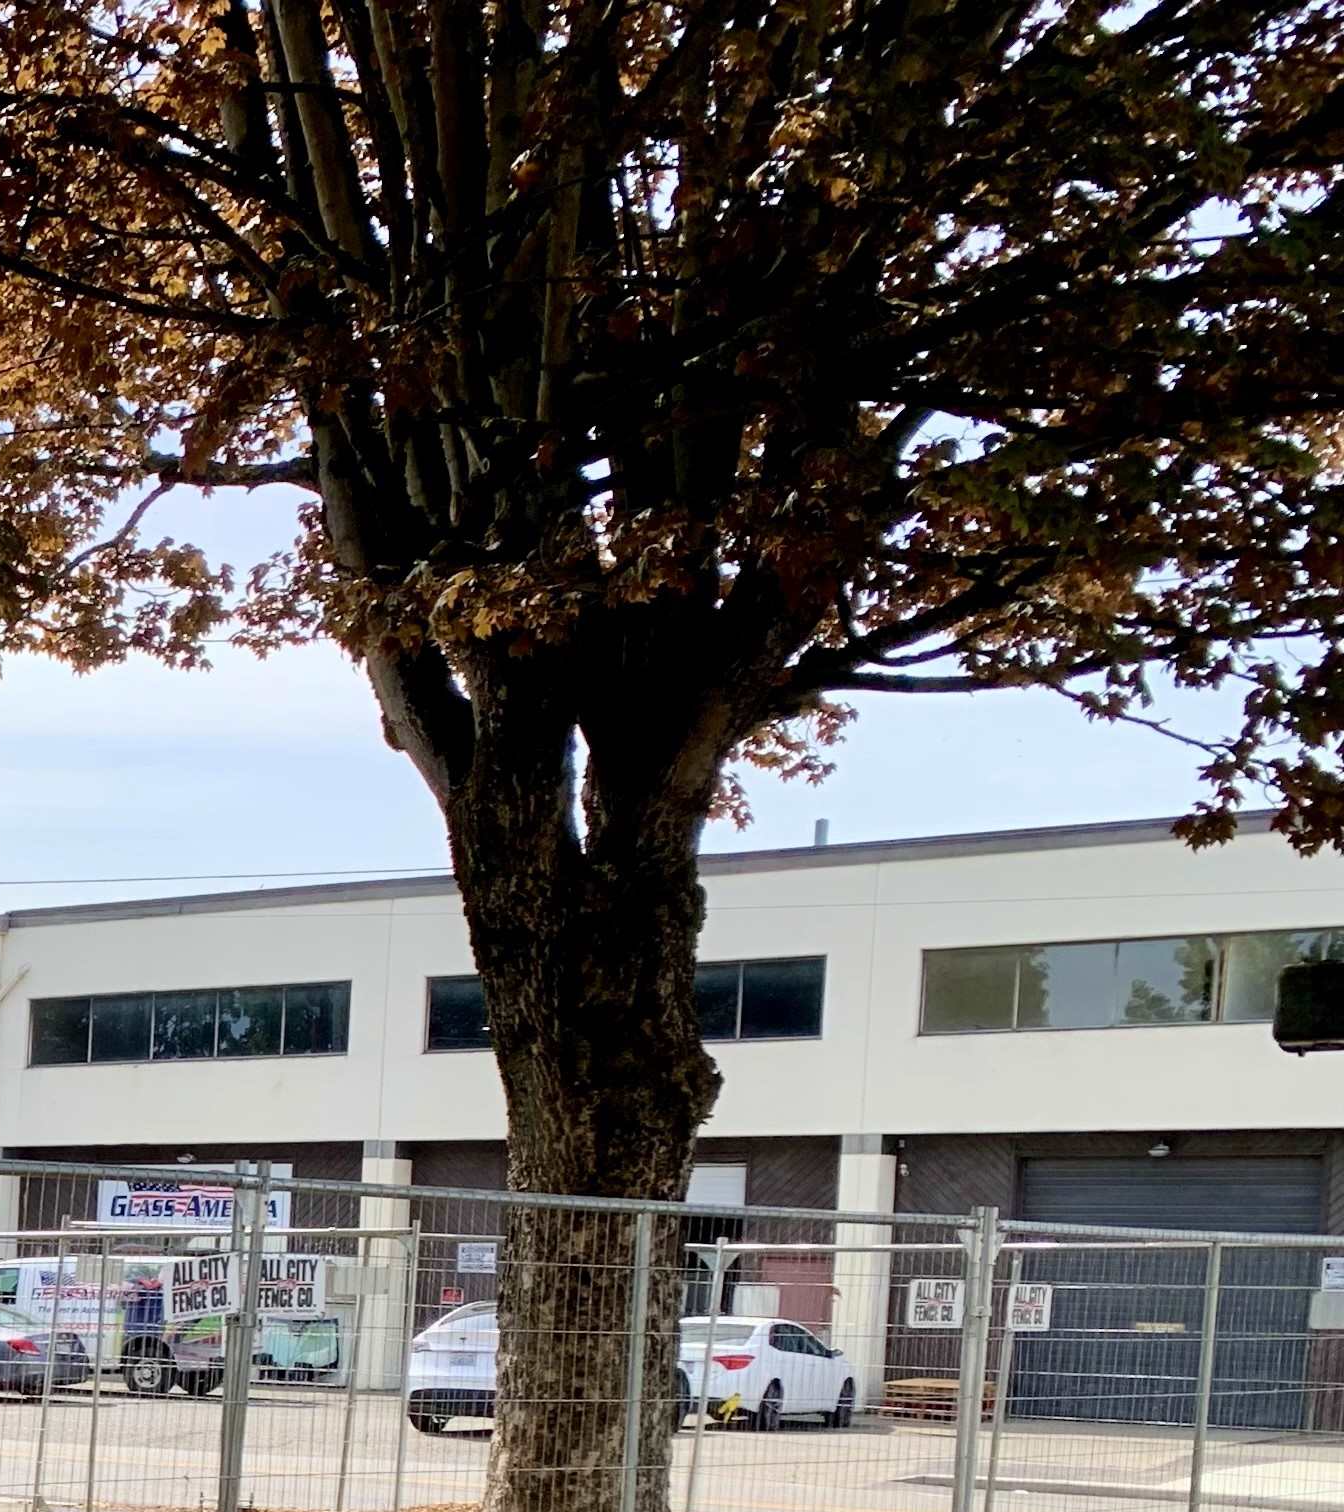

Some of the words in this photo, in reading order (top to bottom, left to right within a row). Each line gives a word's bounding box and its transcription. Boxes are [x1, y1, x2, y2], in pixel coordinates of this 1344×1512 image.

[172, 1262, 192, 1287] ALL
[199, 1255, 230, 1281] CITY
[262, 1258, 282, 1282] ALL
[286, 1258, 318, 1282] CITY
[172, 1288, 207, 1314] FENCE
[212, 1286, 232, 1308] CO.
[257, 1287, 293, 1308] FENCE
[297, 1287, 317, 1308] CO.
[916, 1281, 932, 1299] ALL
[934, 1281, 958, 1300] CITY
